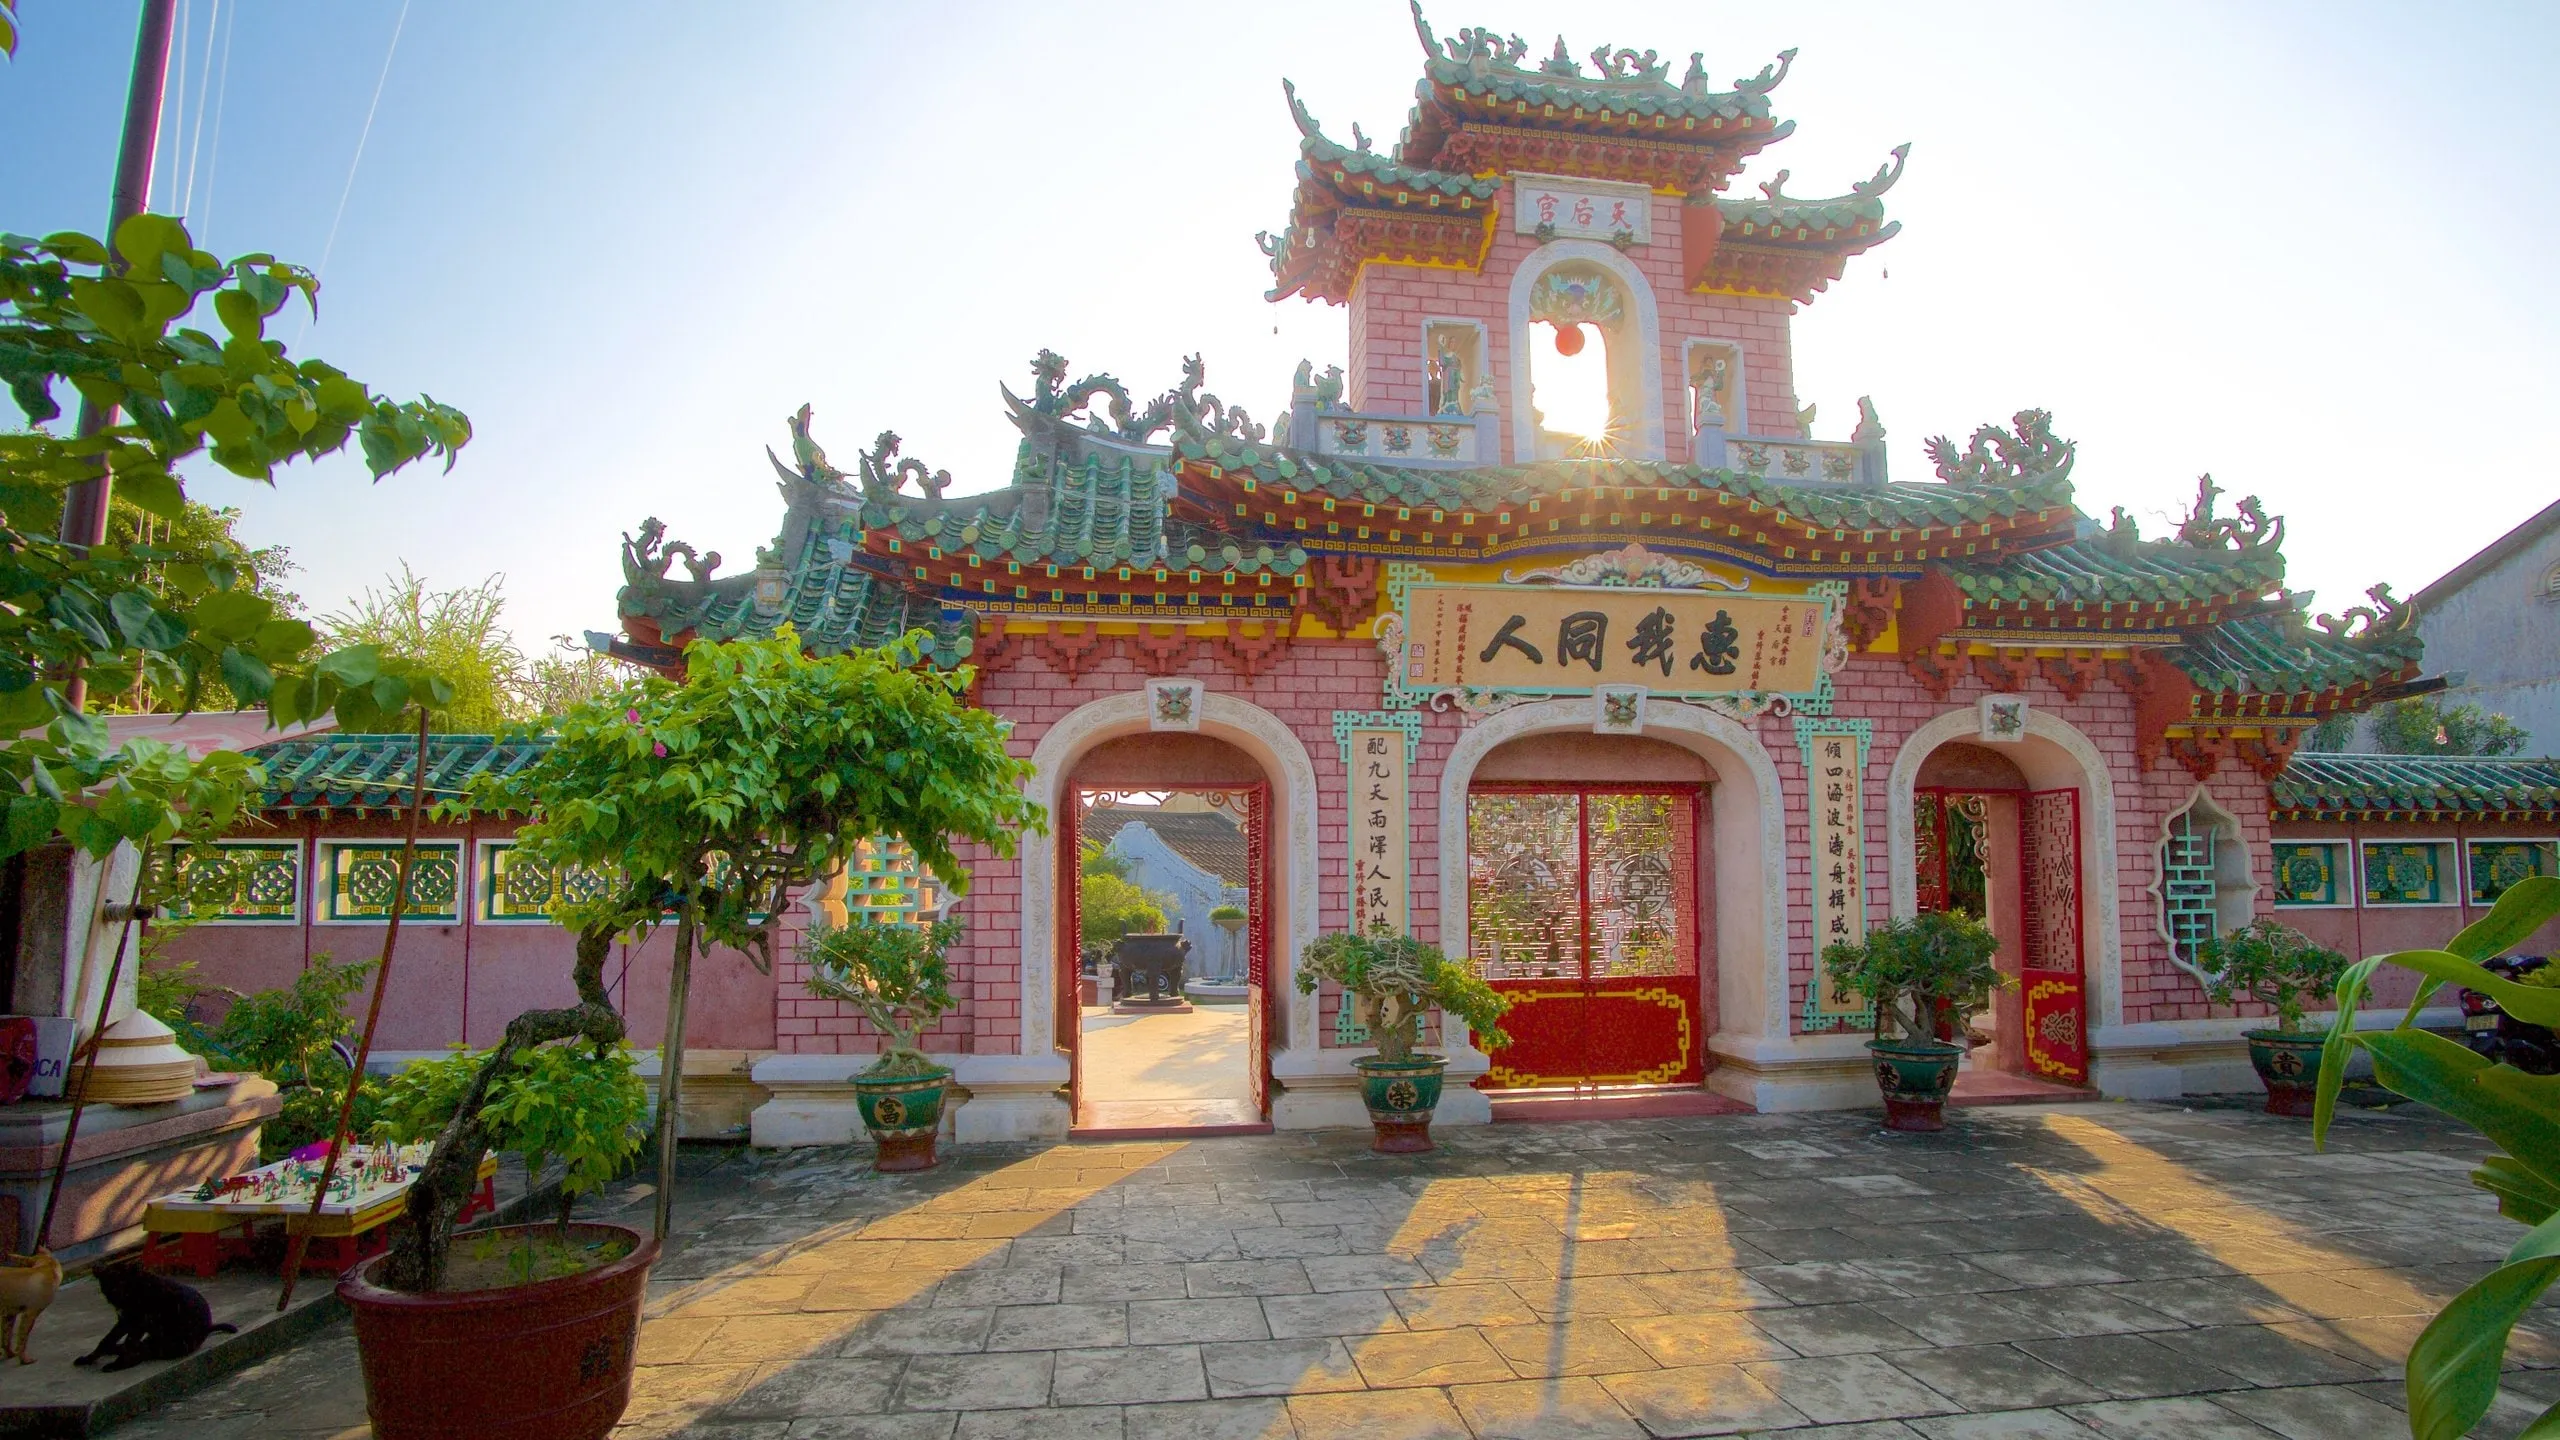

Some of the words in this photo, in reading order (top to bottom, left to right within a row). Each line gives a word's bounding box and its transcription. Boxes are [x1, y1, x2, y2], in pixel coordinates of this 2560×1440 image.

[1480, 606, 1739, 677] 惠我同人
[1367, 737, 1391, 1017] 配九天雨澤人民共
[1825, 741, 1851, 1005] 傾四海波濤舟楫咸化
